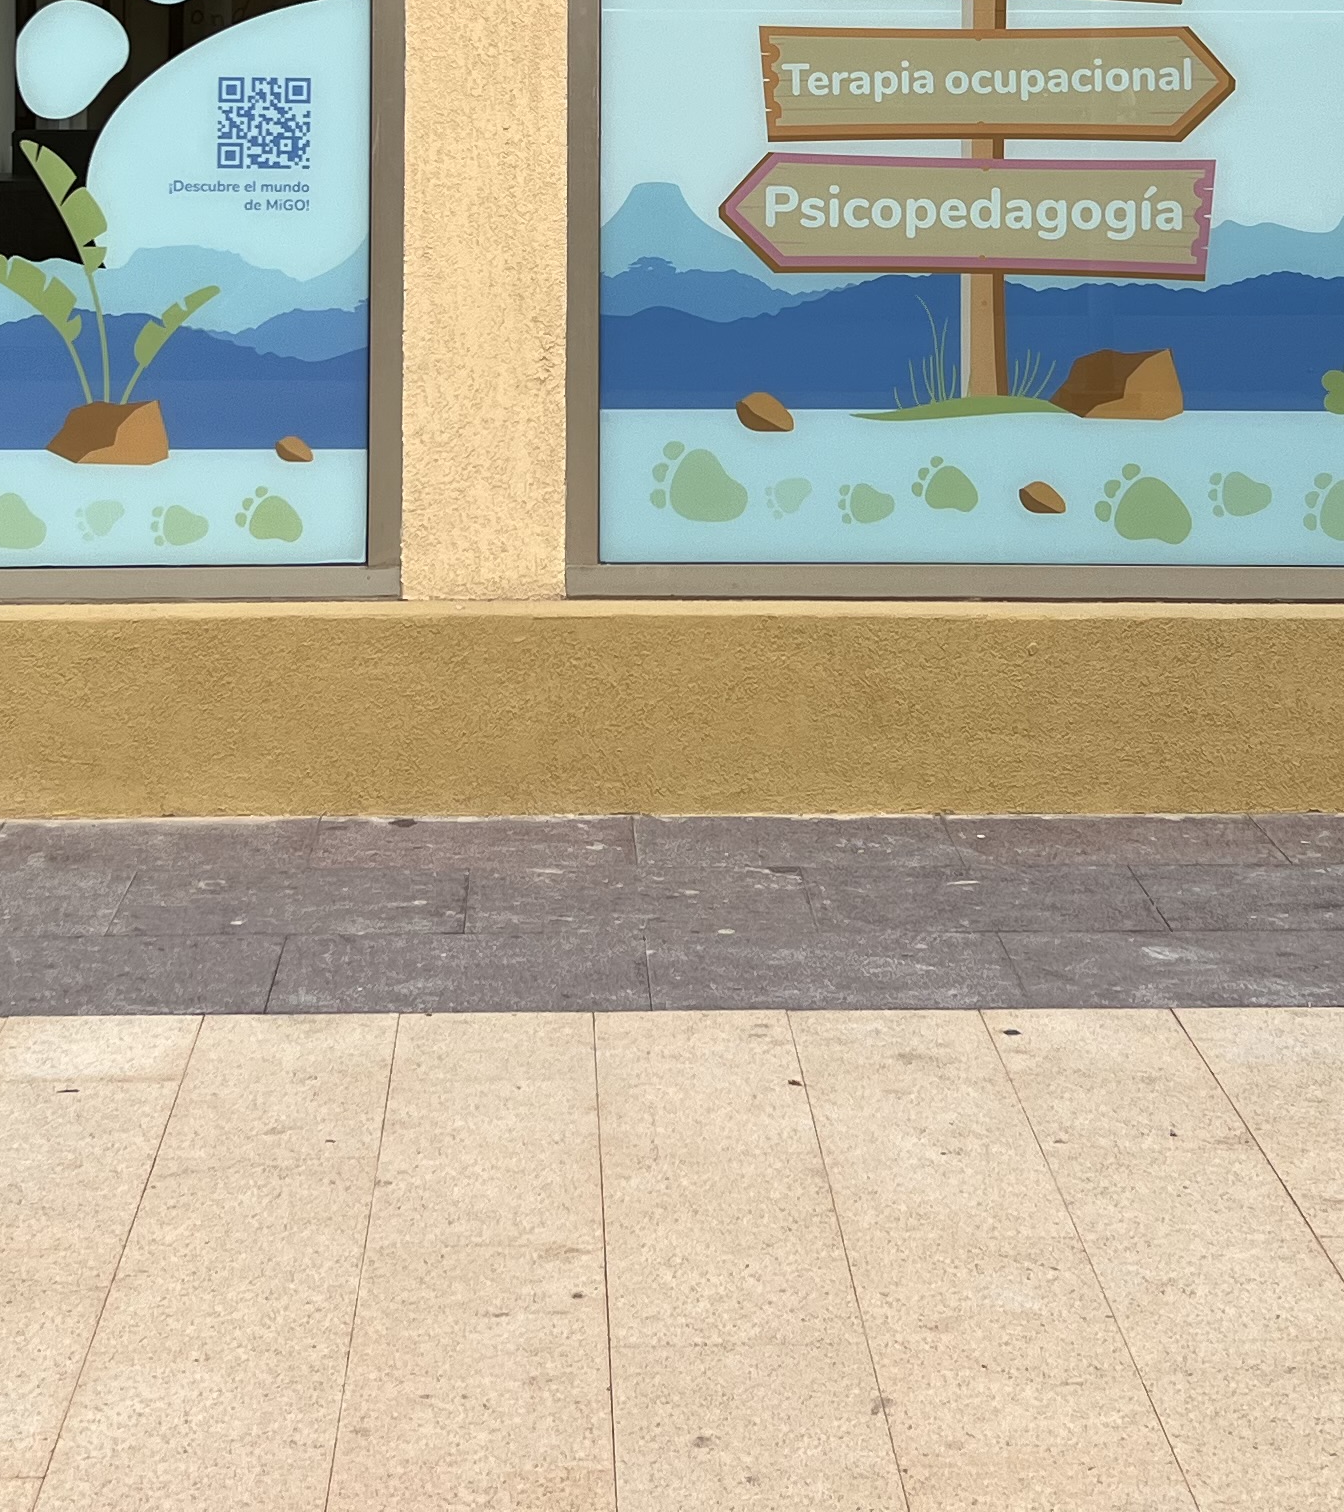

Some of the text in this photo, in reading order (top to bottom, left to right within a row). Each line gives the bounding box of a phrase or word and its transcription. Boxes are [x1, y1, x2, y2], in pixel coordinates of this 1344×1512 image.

[781, 58, 1193, 103] Terapia ocupacional
[168, 179, 310, 195] ¡Descubre el mundo
[244, 199, 310, 211] de MiGO!
[764, 185, 1183, 241] Psicopedagogía
